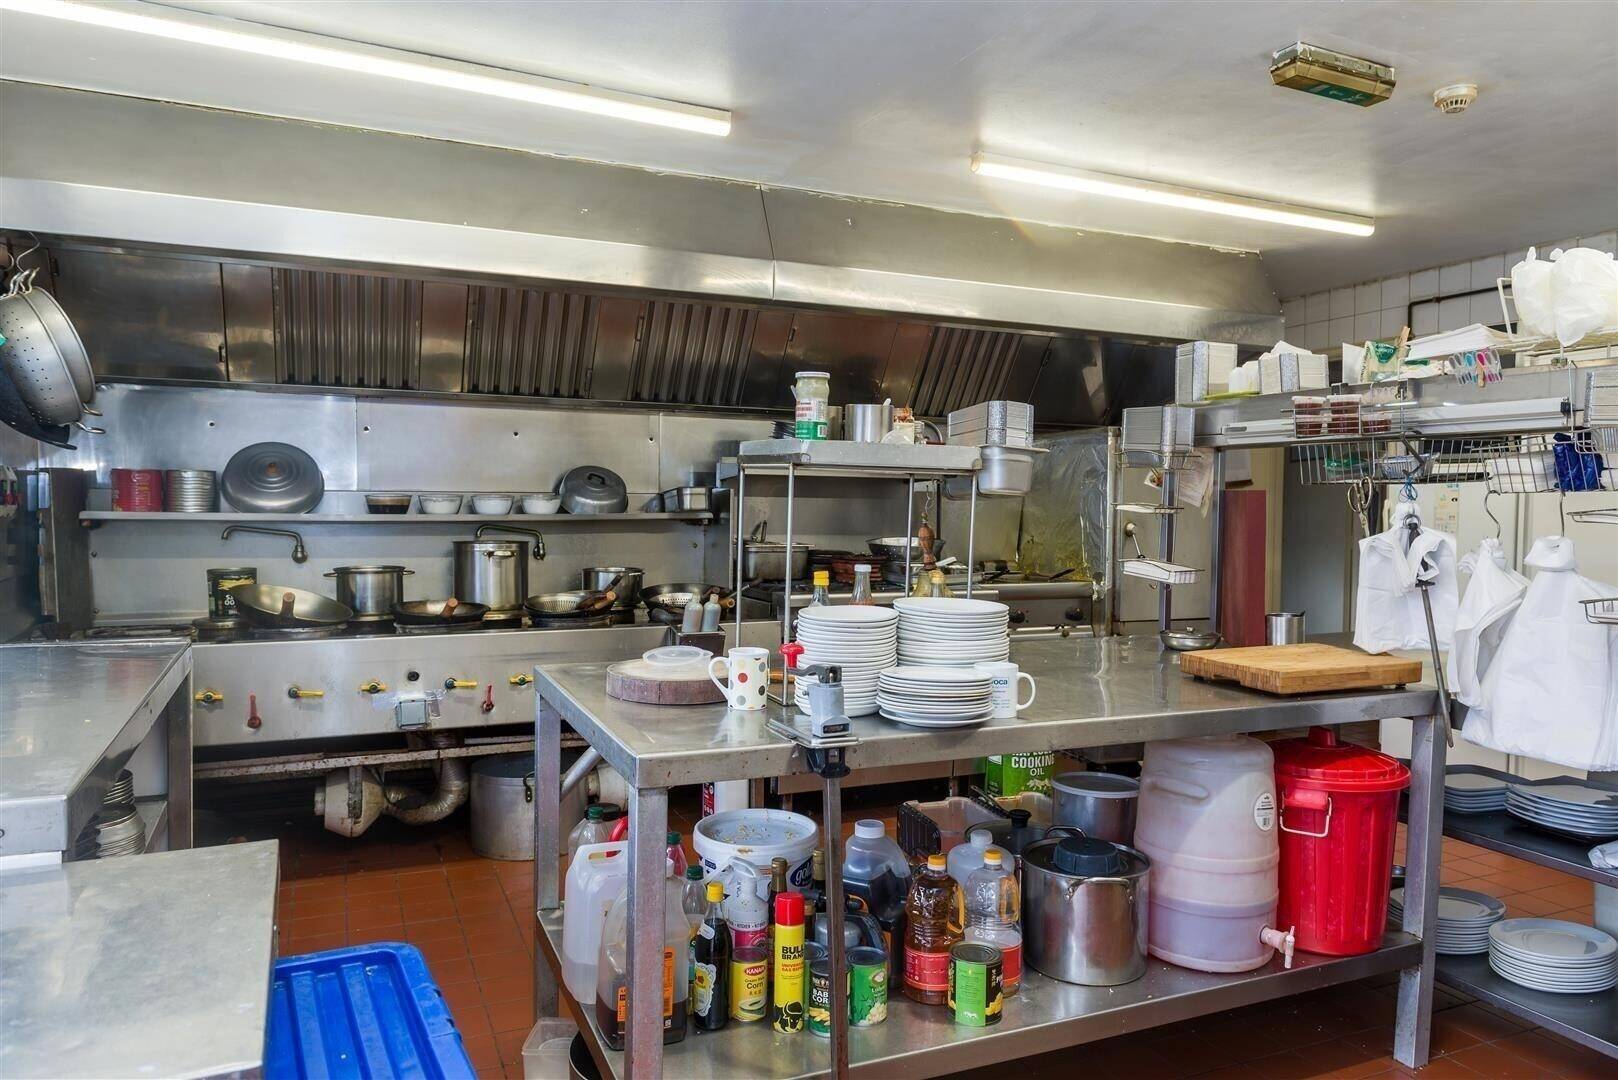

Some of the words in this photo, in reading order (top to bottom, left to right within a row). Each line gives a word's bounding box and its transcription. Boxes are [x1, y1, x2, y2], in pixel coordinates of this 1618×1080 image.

[1030, 768, 1045, 776] OIL
[782, 951, 804, 960] BRAN
[746, 982, 764, 990] Corn
[812, 989, 829, 998] BAB
[812, 995, 829, 1004] COR
